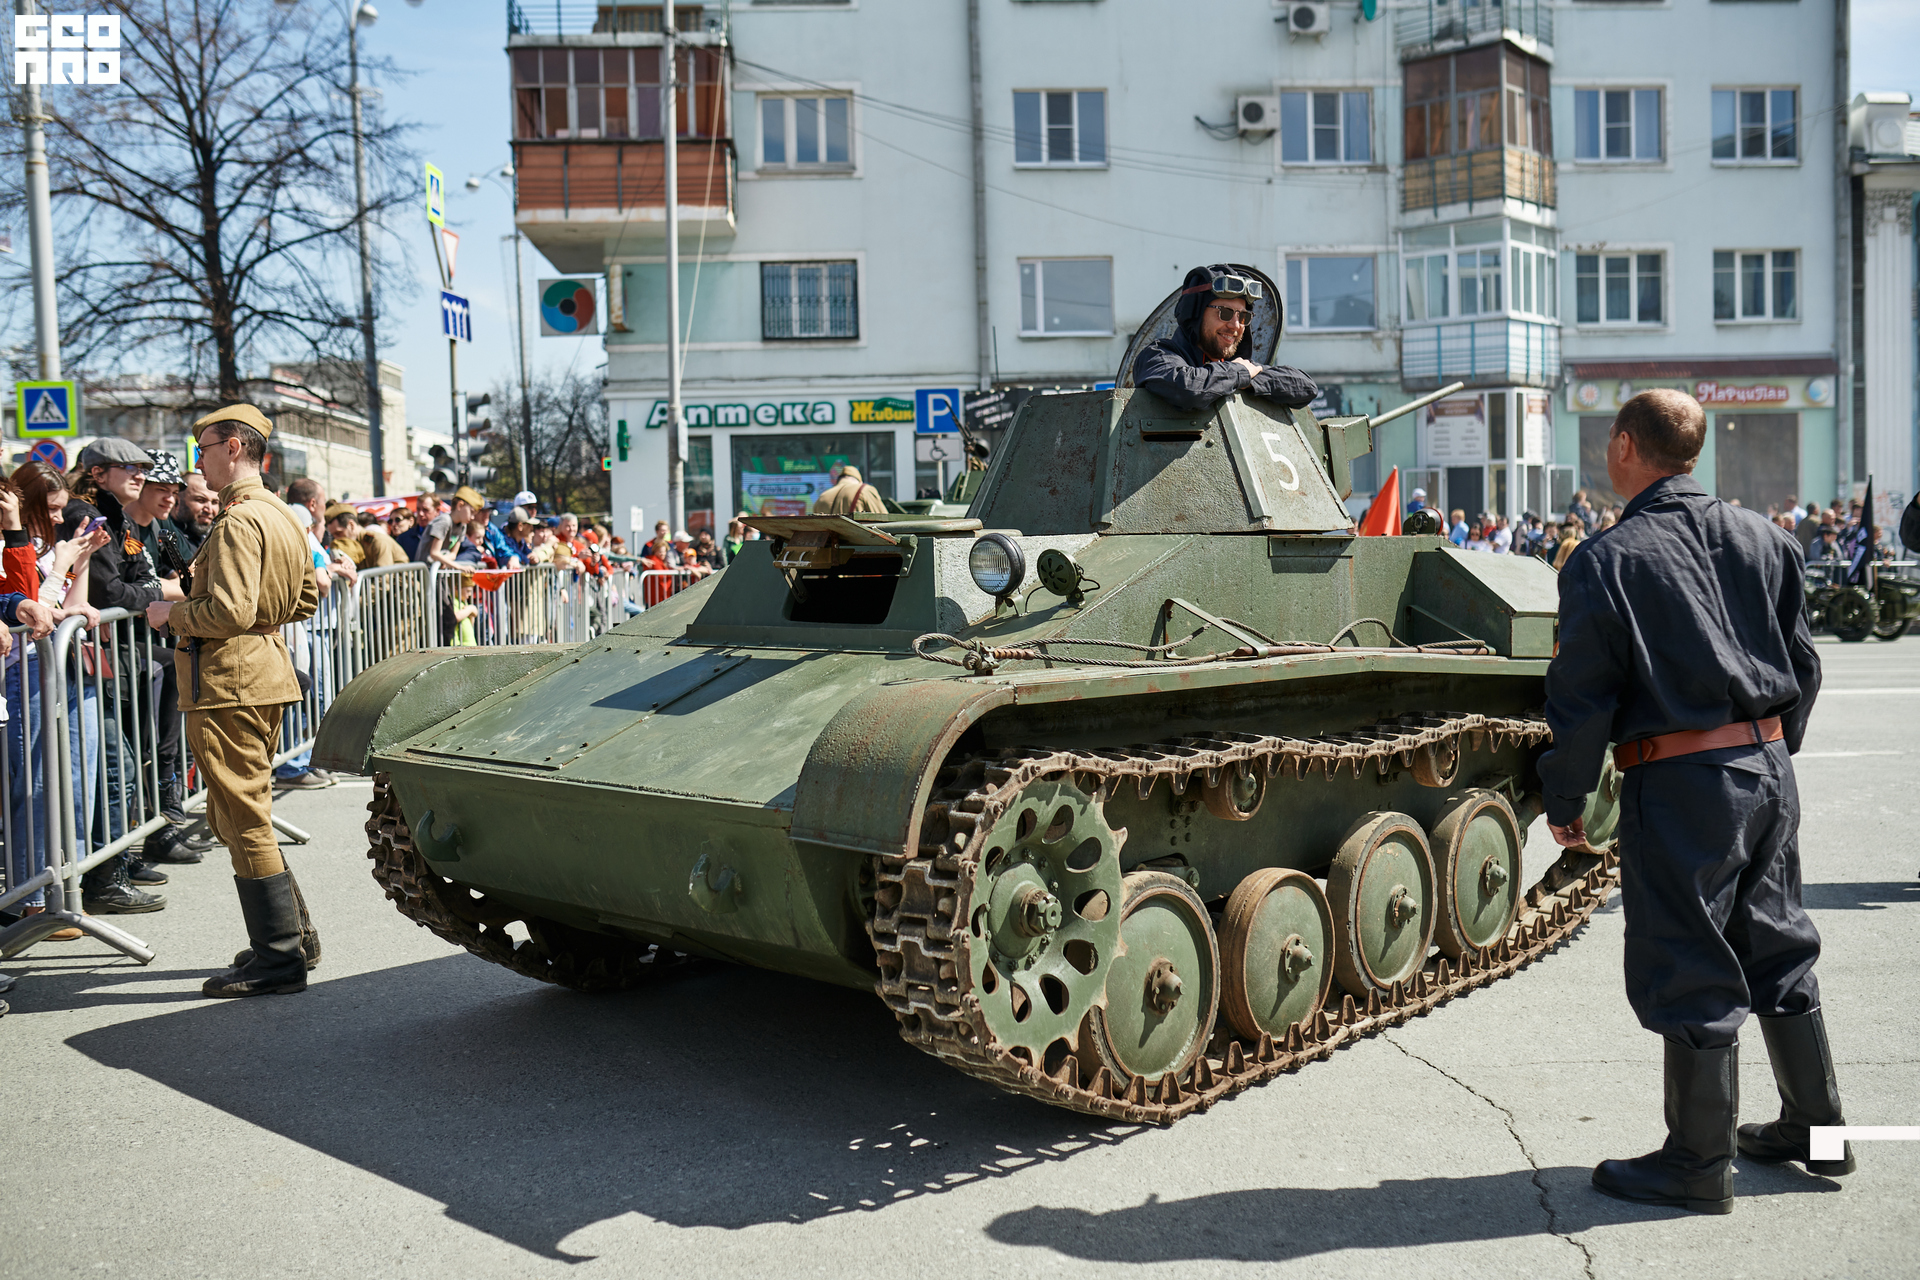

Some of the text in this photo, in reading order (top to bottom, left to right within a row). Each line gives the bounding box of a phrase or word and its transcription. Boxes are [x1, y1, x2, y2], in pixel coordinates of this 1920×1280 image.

[646, 401, 836, 428] Аптека
[852, 401, 915, 422] Живик
[927, 393, 952, 429] P
[1261, 432, 1299, 491] 5
